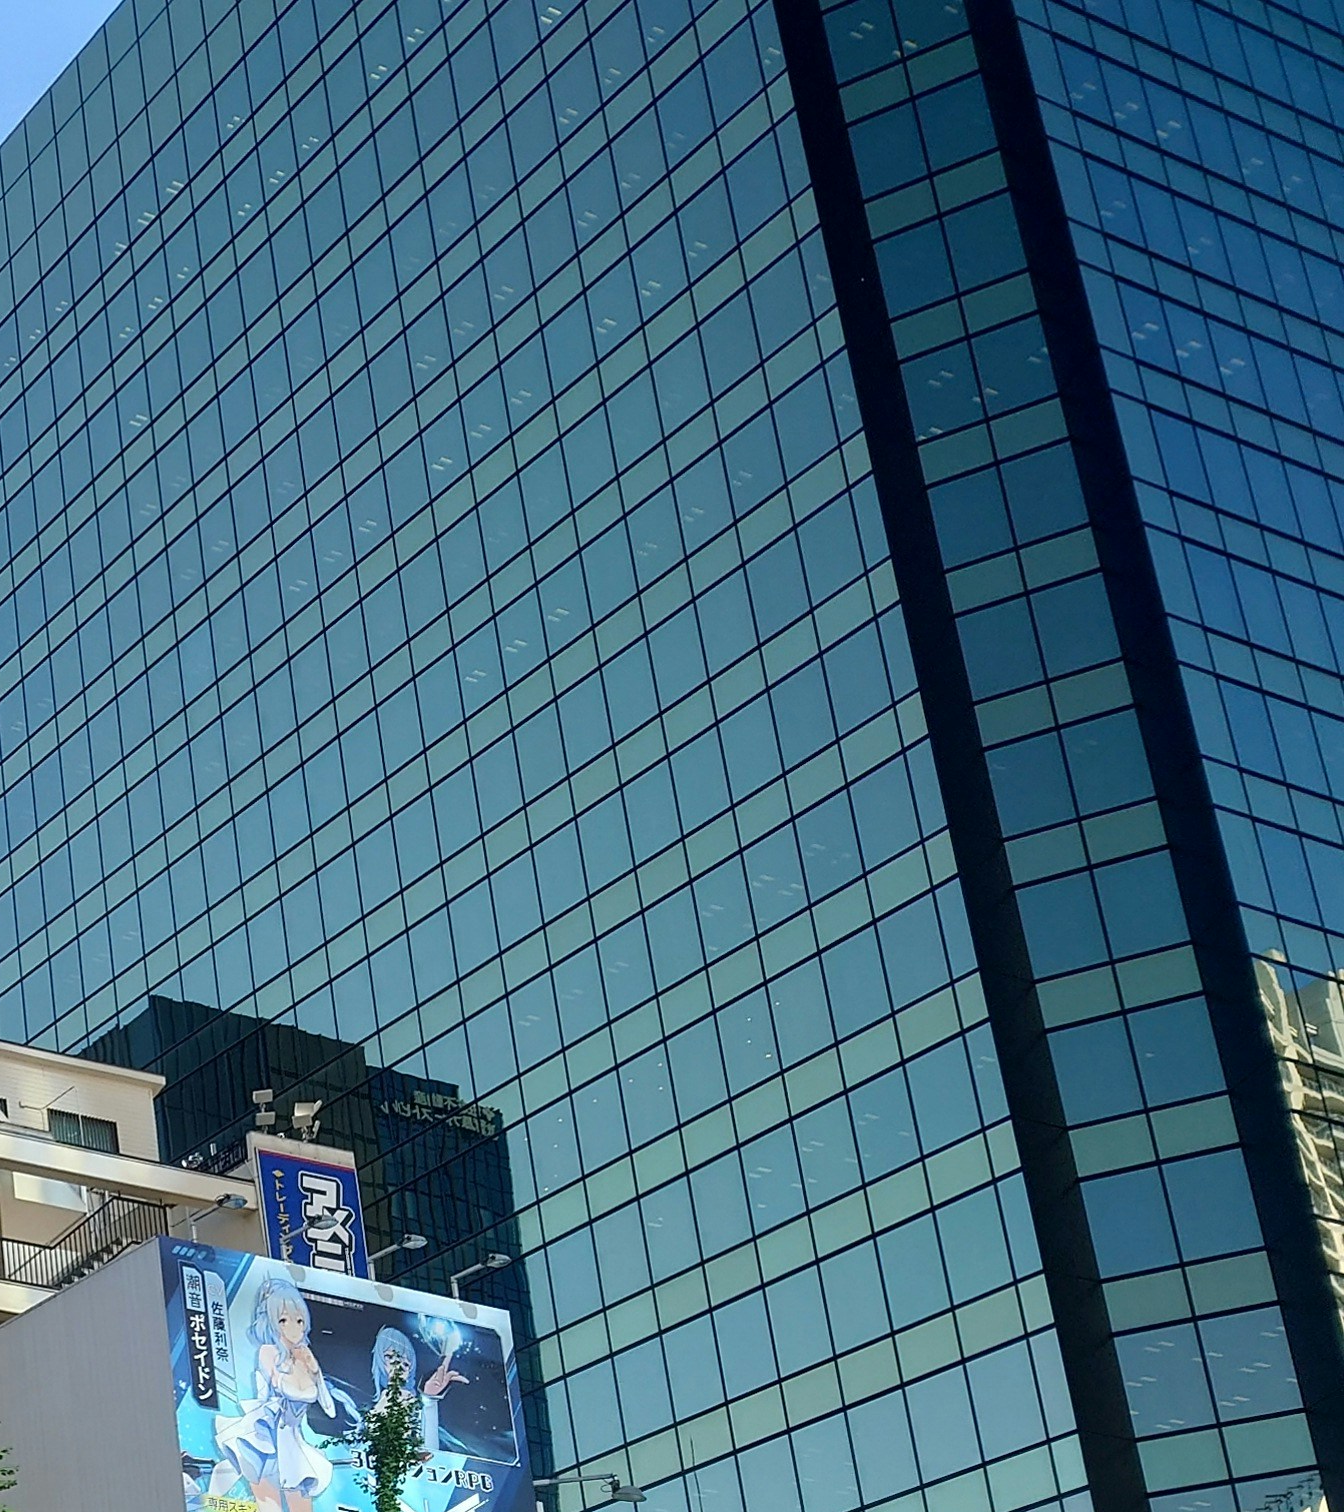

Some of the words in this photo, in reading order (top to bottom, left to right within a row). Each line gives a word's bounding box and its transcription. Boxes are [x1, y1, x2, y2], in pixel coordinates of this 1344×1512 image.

[189, 1314, 213, 1400] ポセイドン
